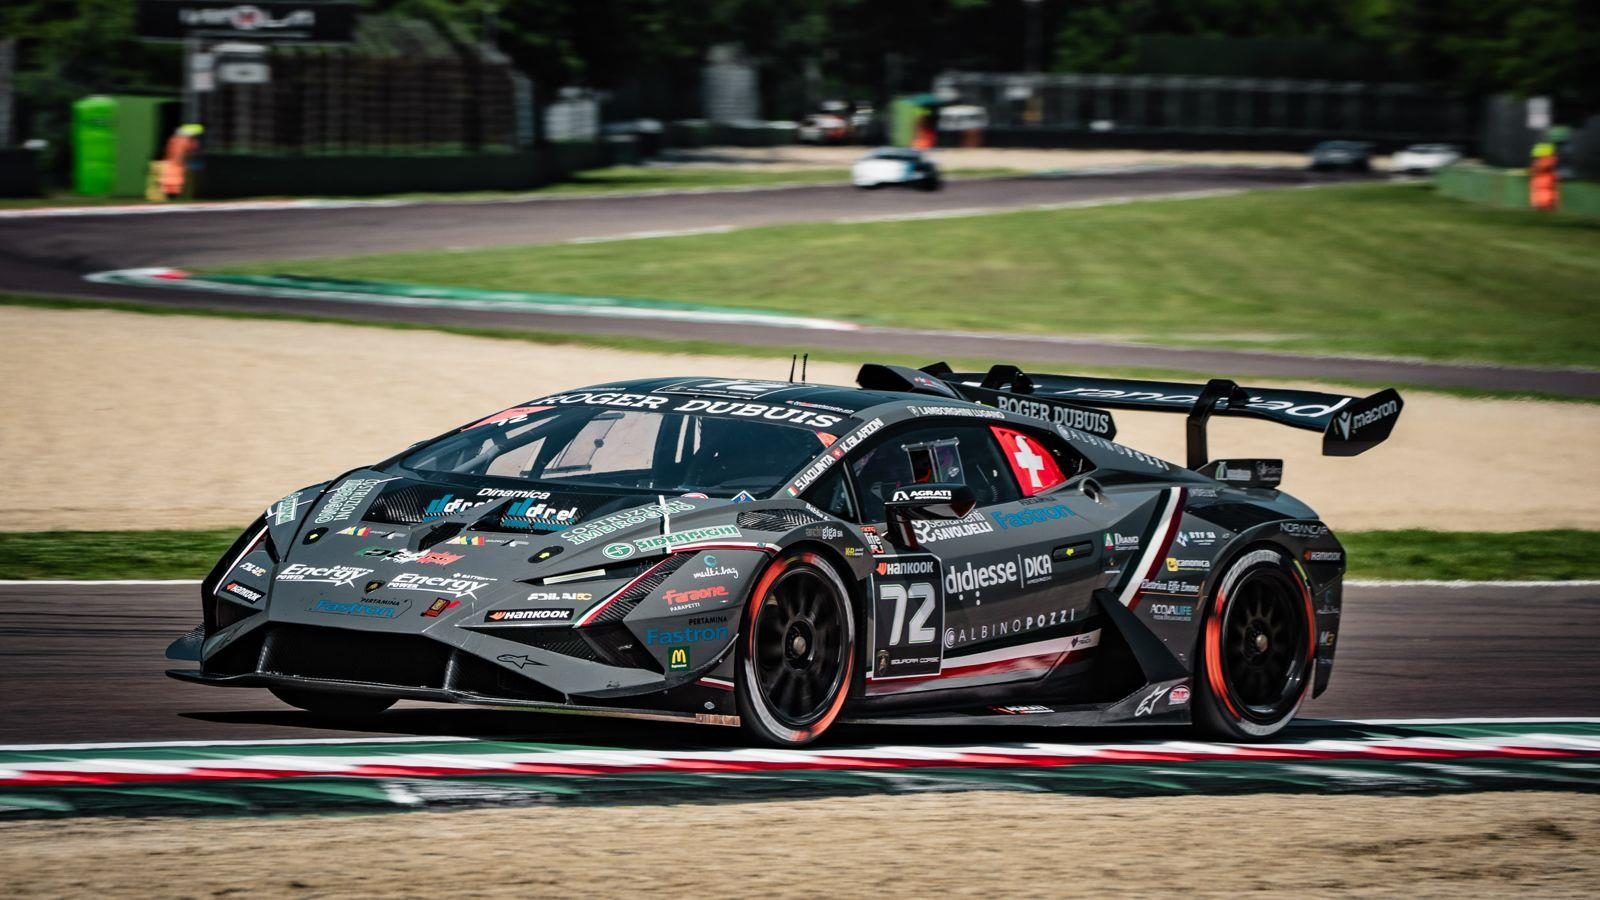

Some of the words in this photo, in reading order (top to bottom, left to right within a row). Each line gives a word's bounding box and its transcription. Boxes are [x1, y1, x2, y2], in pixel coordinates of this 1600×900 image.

[530, 393, 669, 409] ROGER
[673, 400, 842, 428] DUBUIS
[918, 406, 974, 418] LAMBORGHINI
[998, 396, 1050, 422] ROGER
[1053, 406, 1110, 434] DUBUIS
[1353, 400, 1397, 430] macron
[476, 487, 551, 500] Dinamica
[991, 503, 1077, 530] Fastron
[933, 521, 994, 541] SAVOLDELLI
[280, 563, 372, 581] Energy
[1024, 554, 1052, 578] DICA
[392, 573, 489, 592] Energy
[662, 584, 730, 606] faraone
[688, 616, 728, 627] PERTAMINA
[879, 582, 936, 646] 72
[646, 626, 730, 646] Fastron
